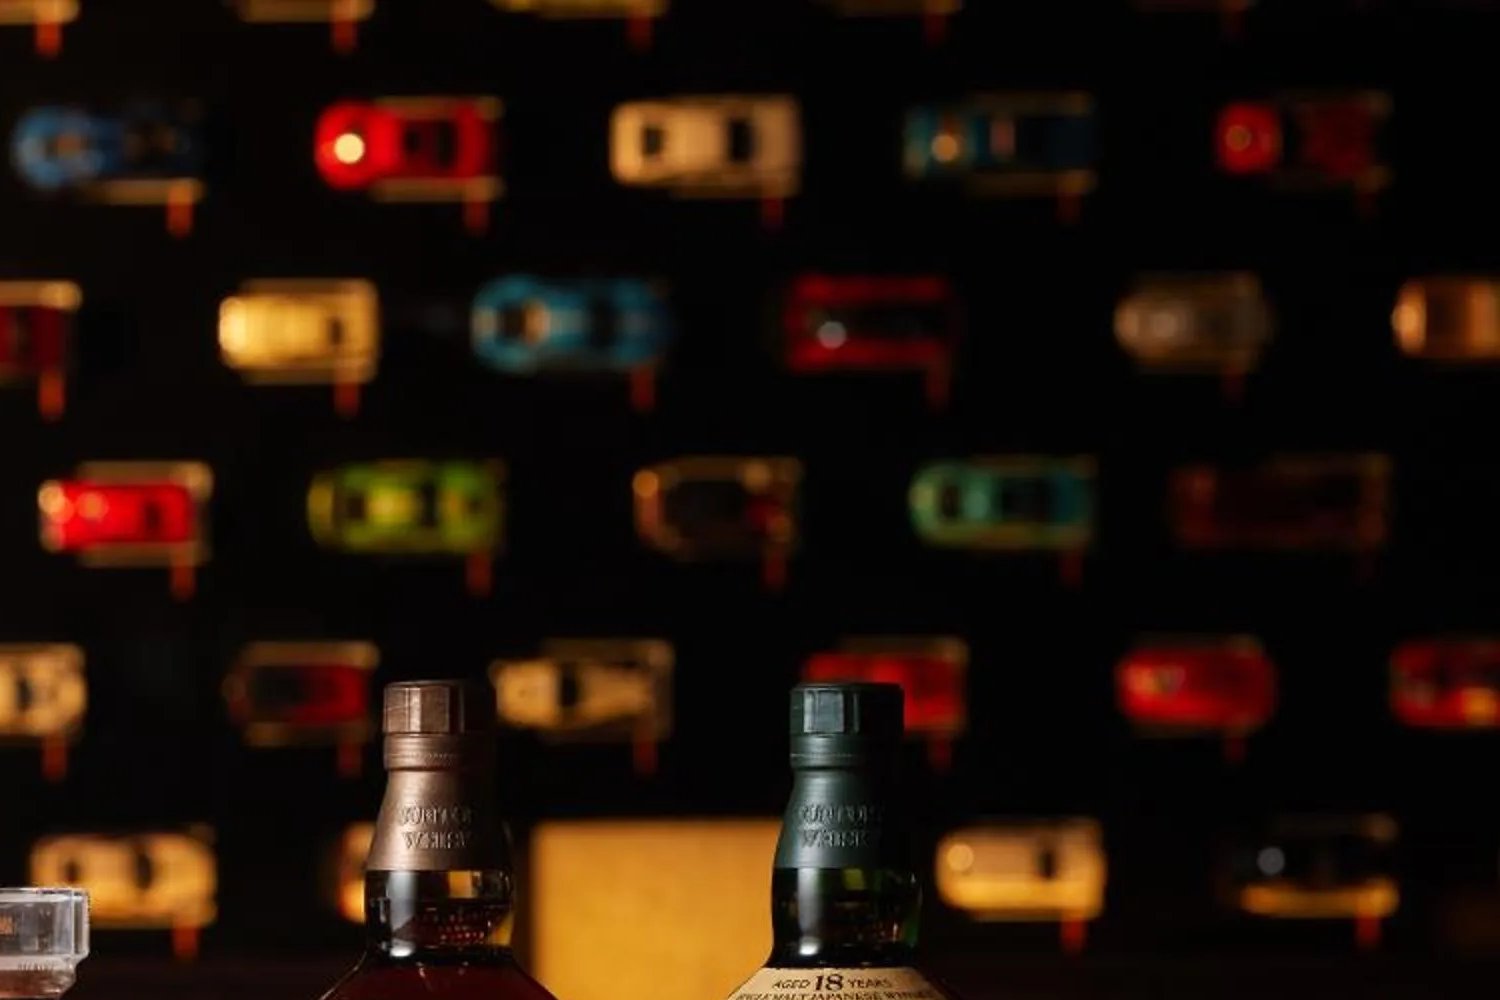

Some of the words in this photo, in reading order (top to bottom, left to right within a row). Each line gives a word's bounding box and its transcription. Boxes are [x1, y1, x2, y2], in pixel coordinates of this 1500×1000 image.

[772, 979, 810, 989] AGED
[815, 973, 844, 991] 18
[848, 979, 892, 989] YEARS
